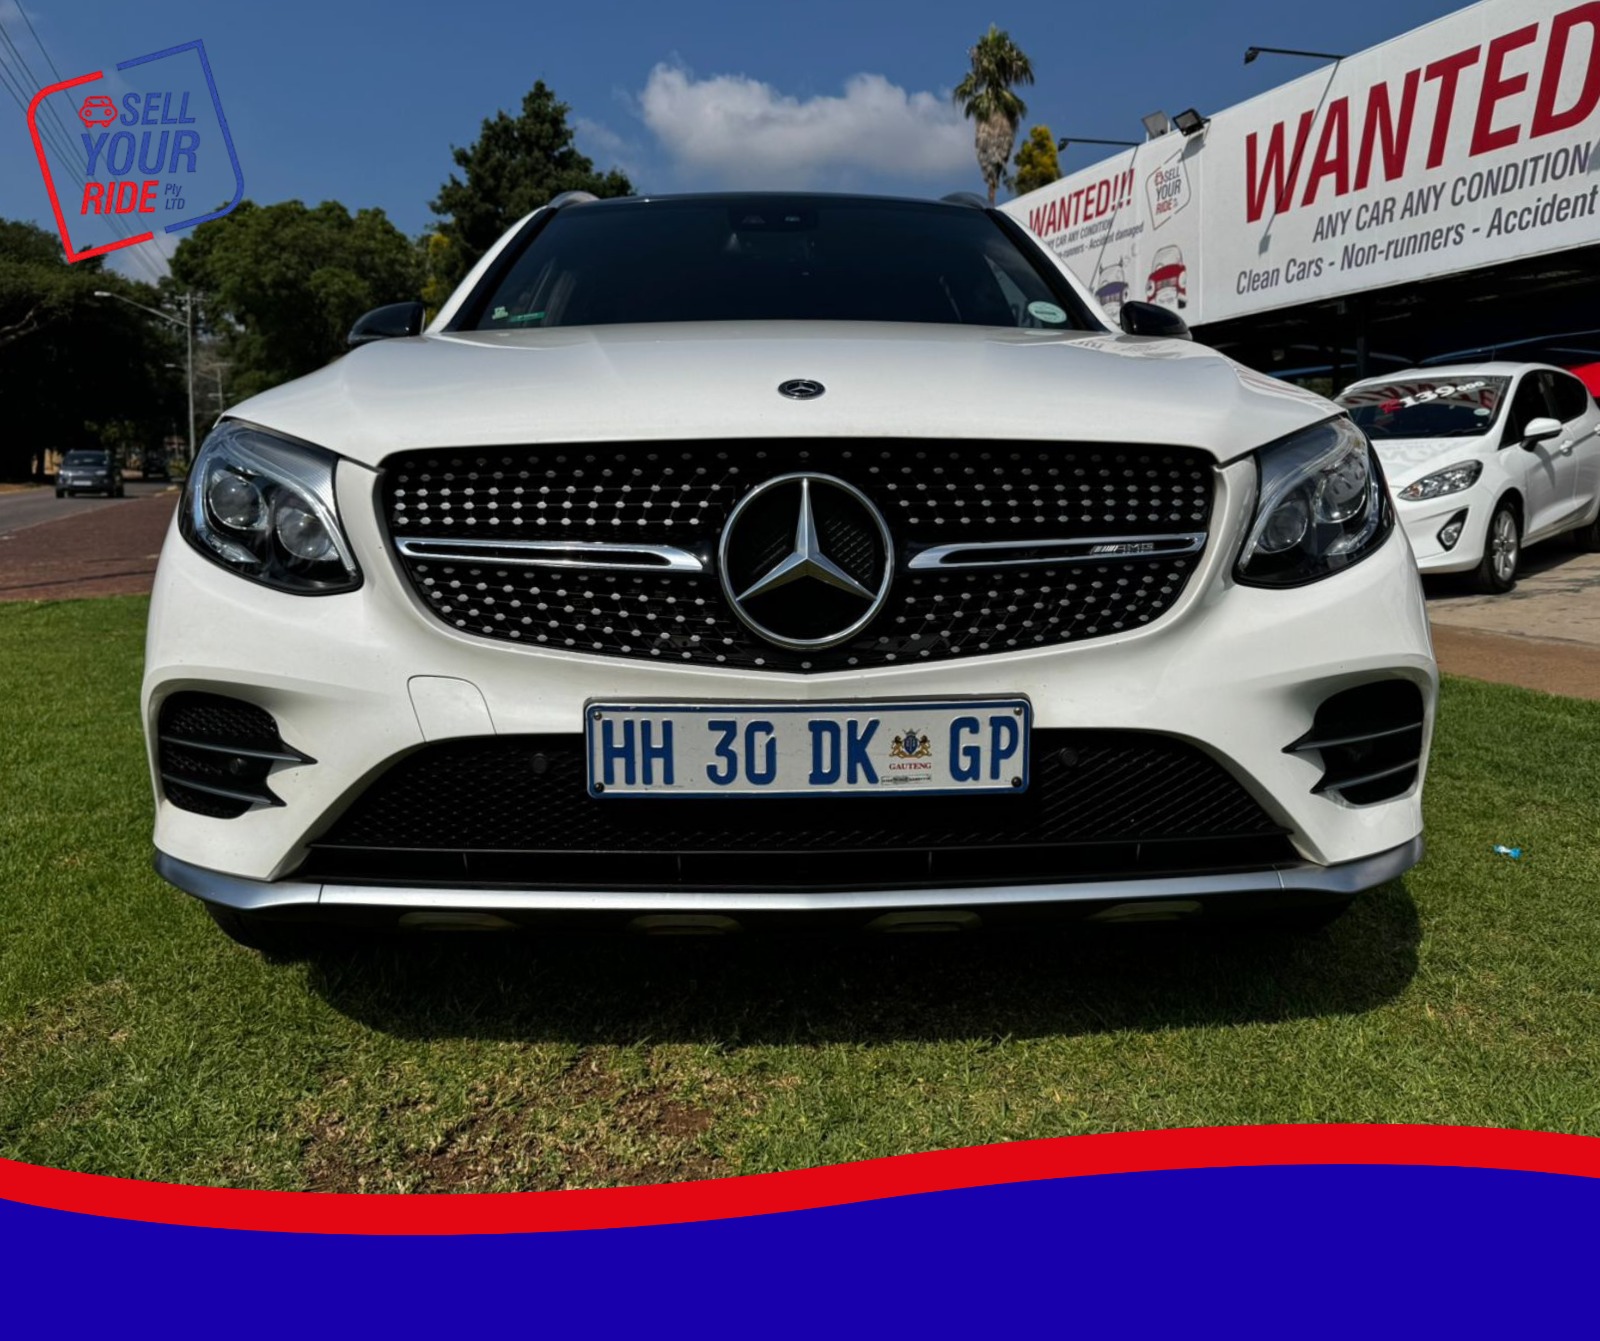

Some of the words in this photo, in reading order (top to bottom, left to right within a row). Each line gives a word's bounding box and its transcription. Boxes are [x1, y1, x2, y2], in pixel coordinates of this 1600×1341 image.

[1246, 1, 1600, 223] WANTED
[1156, 179, 1181, 201] YOUR
[1164, 166, 1180, 183] SELL
[1312, 208, 1352, 243] ANY
[1355, 197, 1397, 231] CAR
[1400, 182, 1447, 220] ANY
[1451, 141, 1592, 207] CONDITION
[1029, 168, 1135, 238] WANTED!!!
[1055, 234, 1067, 248] CAR
[1068, 230, 1080, 243] ANY
[1115, 220, 1145, 241] damaged
[1236, 265, 1280, 295] Clean
[1284, 257, 1323, 284] Cars
[1340, 222, 1465, 271] Non-runners
[1486, 184, 1599, 238] Accident
[601, 719, 675, 786] HH
[706, 719, 777, 786] 30
[808, 718, 881, 785] DK
[948, 715, 1020, 782] GP
[888, 762, 932, 770] GAUTENG
